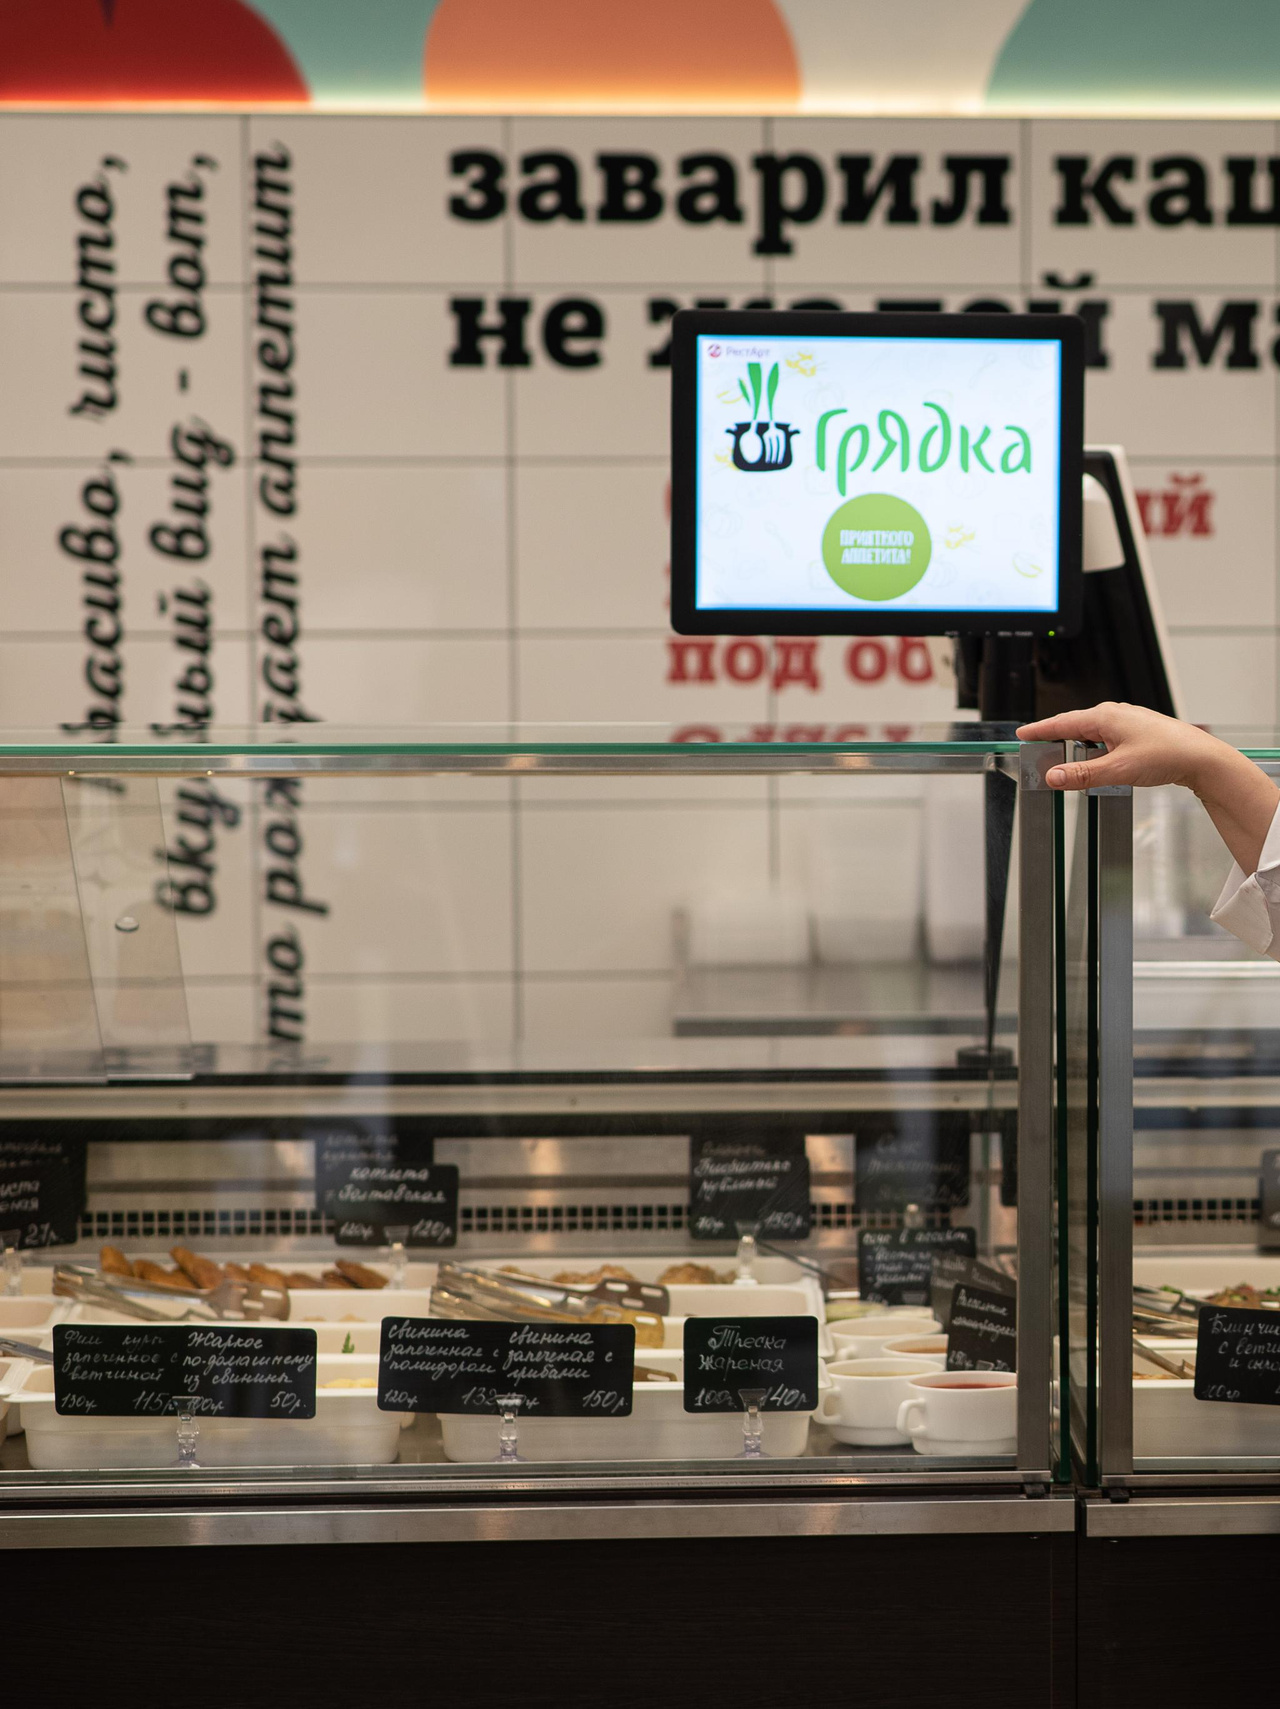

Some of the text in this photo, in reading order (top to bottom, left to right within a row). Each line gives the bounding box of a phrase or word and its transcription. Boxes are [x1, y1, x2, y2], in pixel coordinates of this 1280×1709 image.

[446, 147, 1014, 258] заварил
[143, 152, 220, 340] вот,
[250, 139, 298, 517] аппетит
[446, 294, 607, 370] не
[147, 415, 237, 563] вид
[665, 635, 820, 693] под
[182, 1354, 314, 1376] по-домашнему
[188, 1331, 264, 1356] Жаркое
[183, 1374, 200, 1392] из
